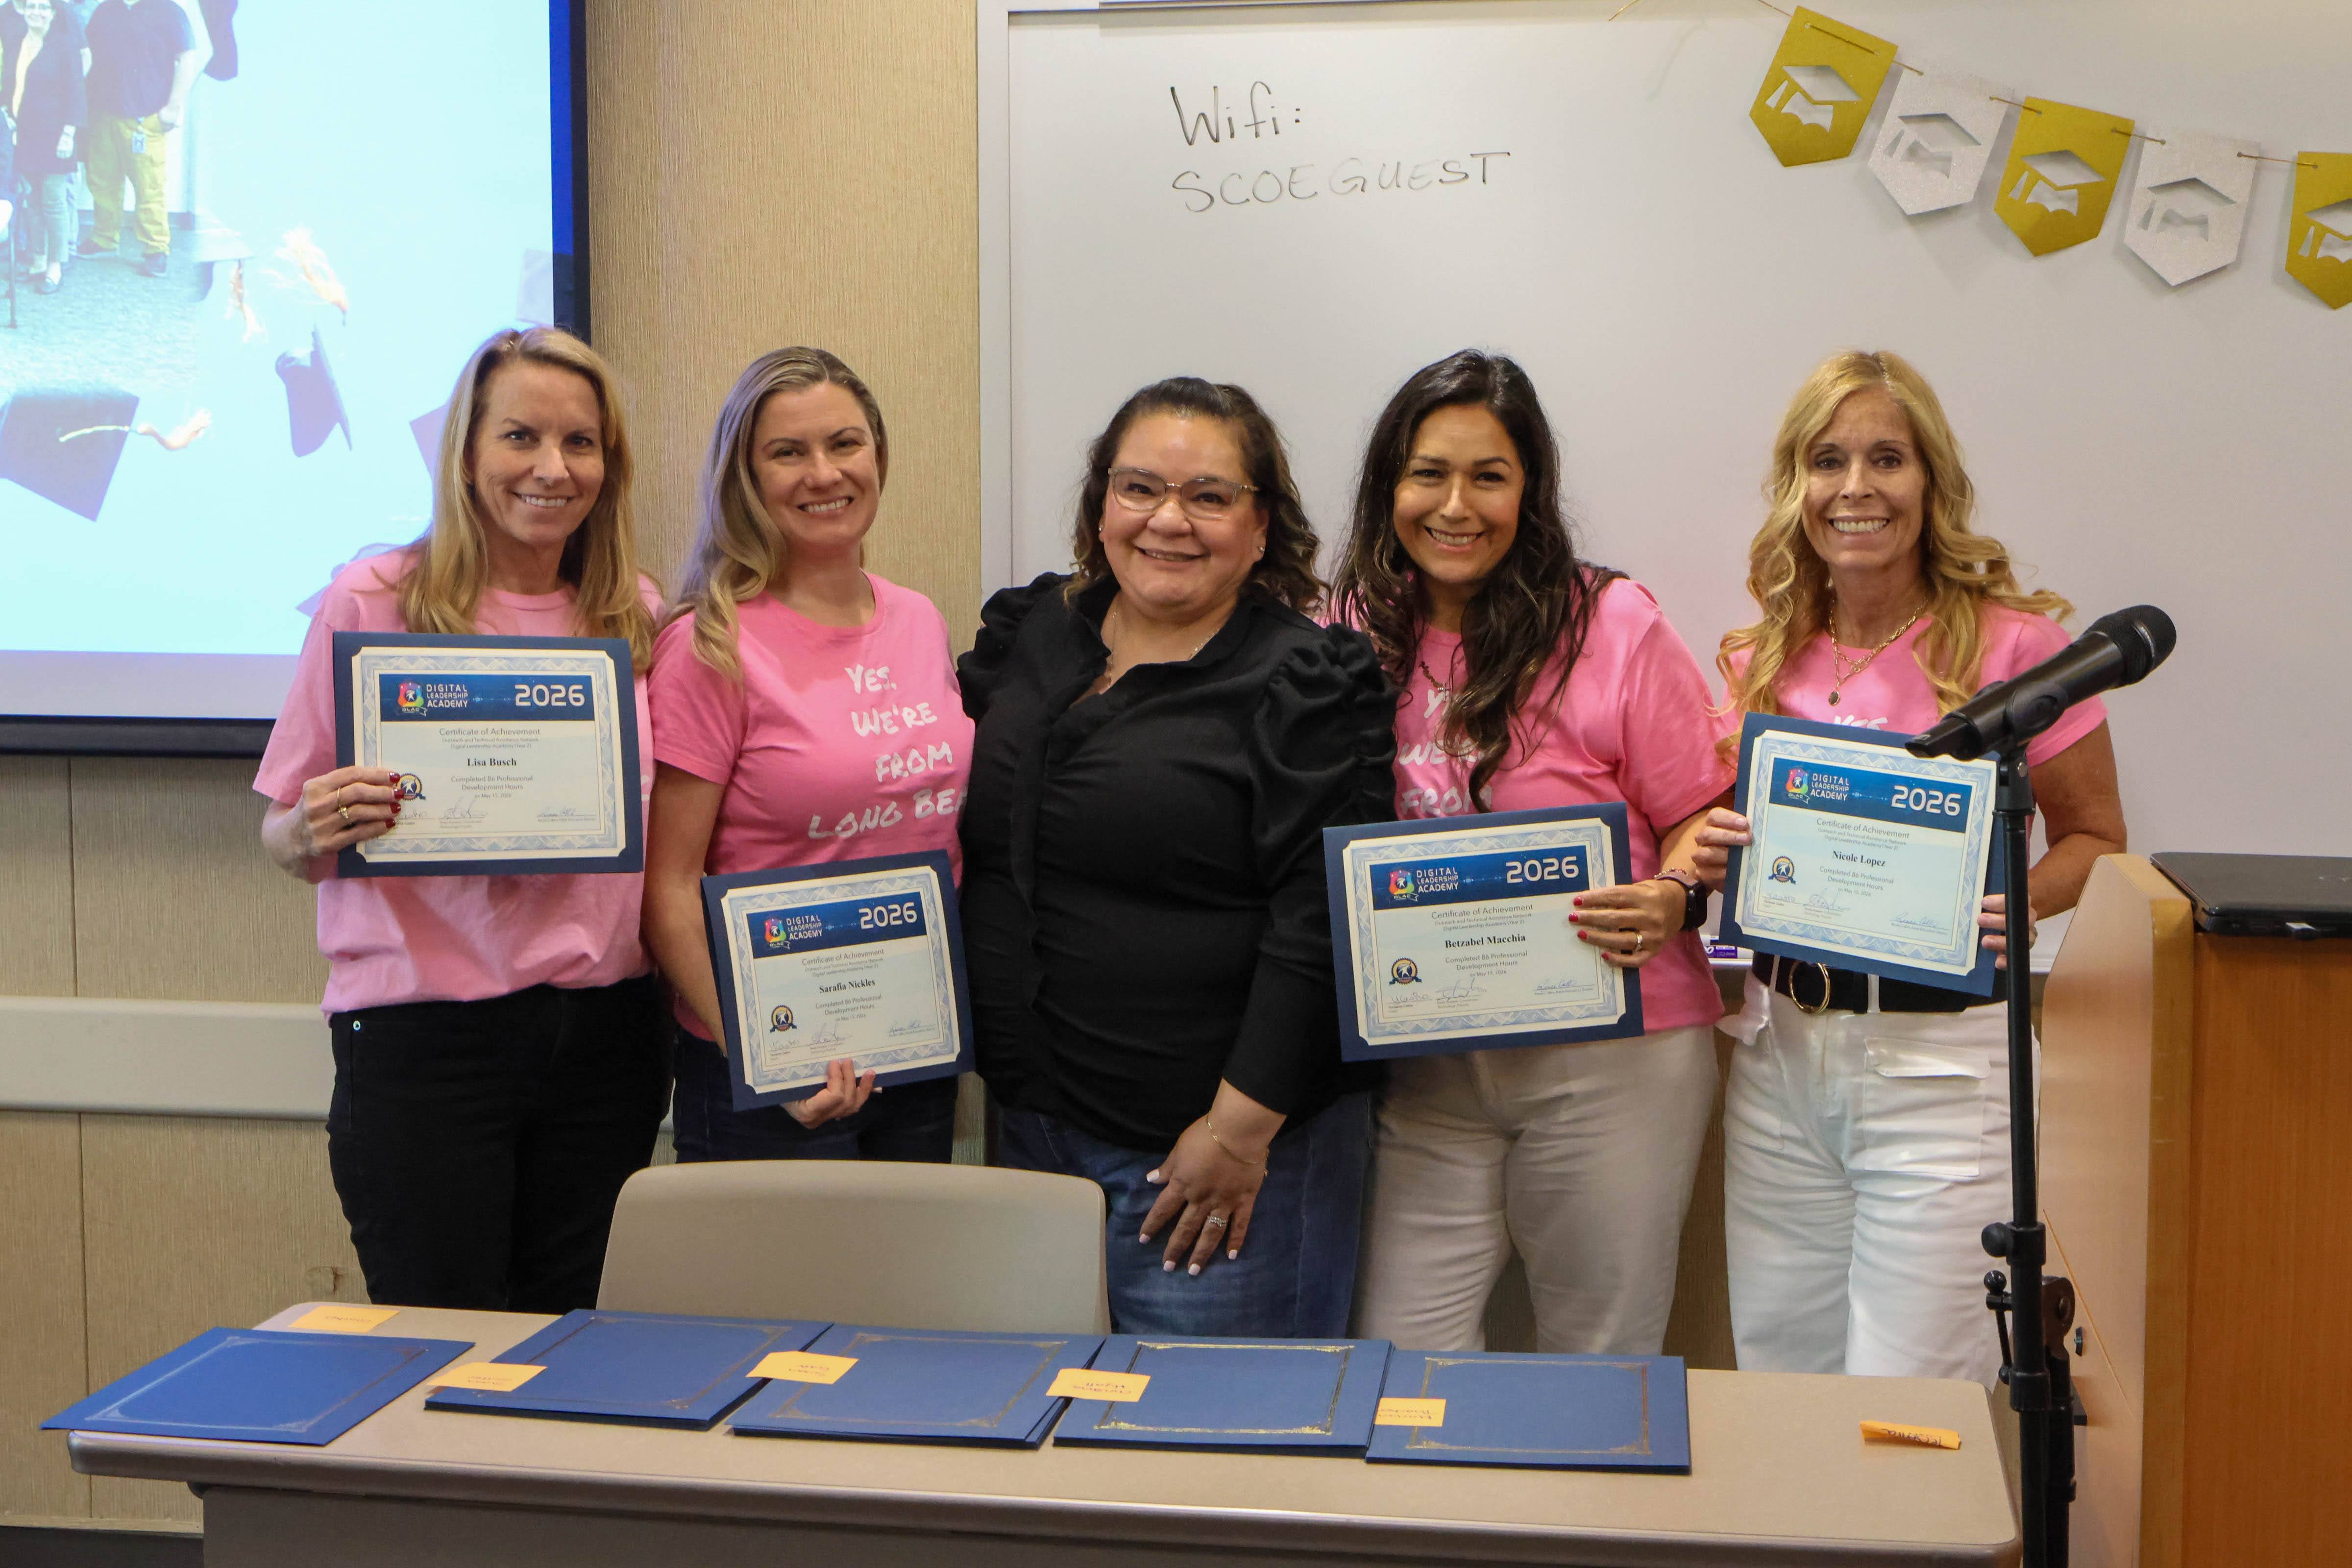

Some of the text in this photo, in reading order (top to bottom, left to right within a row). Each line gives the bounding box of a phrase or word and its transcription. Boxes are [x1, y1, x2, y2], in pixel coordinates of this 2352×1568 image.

[1170, 81, 1300, 146] Wifi:
[514, 684, 586, 706] 2026
[851, 702, 937, 736] WE'RE
[490, 758, 516, 766] Busch
[875, 741, 953, 783] FROM
[1812, 781, 1849, 792] LEADERSHIP
[1813, 773, 1850, 785] DIGITAL
[1811, 788, 1848, 801] ACADEMY
[1890, 784, 1962, 817] 2026
[808, 801, 903, 839] LONG
[1816, 817, 1910, 839] Certificate of Achievement
[1832, 850, 1886, 869] Nicole Lopez
[1417, 867, 1457, 878] DIGITAL
[1505, 855, 1580, 884] 2026
[1819, 865, 1850, 878] Completed
[1860, 872, 1894, 883] Professional
[1417, 875, 1458, 884] LEADERSHIP
[1827, 876, 1884, 890] Development Hours
[1418, 882, 1459, 893] ACADEMY
[858, 901, 918, 930] 2026
[1431, 908, 1470, 919] Certificate
[1482, 903, 1533, 914] Achievement
[786, 914, 820, 925] DIGITAL
[787, 922, 822, 931] LEADERSHIP
[788, 929, 823, 940] ACADEMY
[1445, 933, 1525, 948] Betzabel Macchia
[802, 955, 834, 966] Certificate
[843, 947, 884, 960] Achievement
[1445, 955, 1480, 964] Completed
[1491, 950, 1527, 959] Professional
[1456, 961, 1498, 971] Development
[818, 978, 875, 993] Sarafia Nickles
[815, 999, 844, 1010] Completed
[852, 993, 882, 1003] Professional
[825, 1005, 859, 1016] Development
